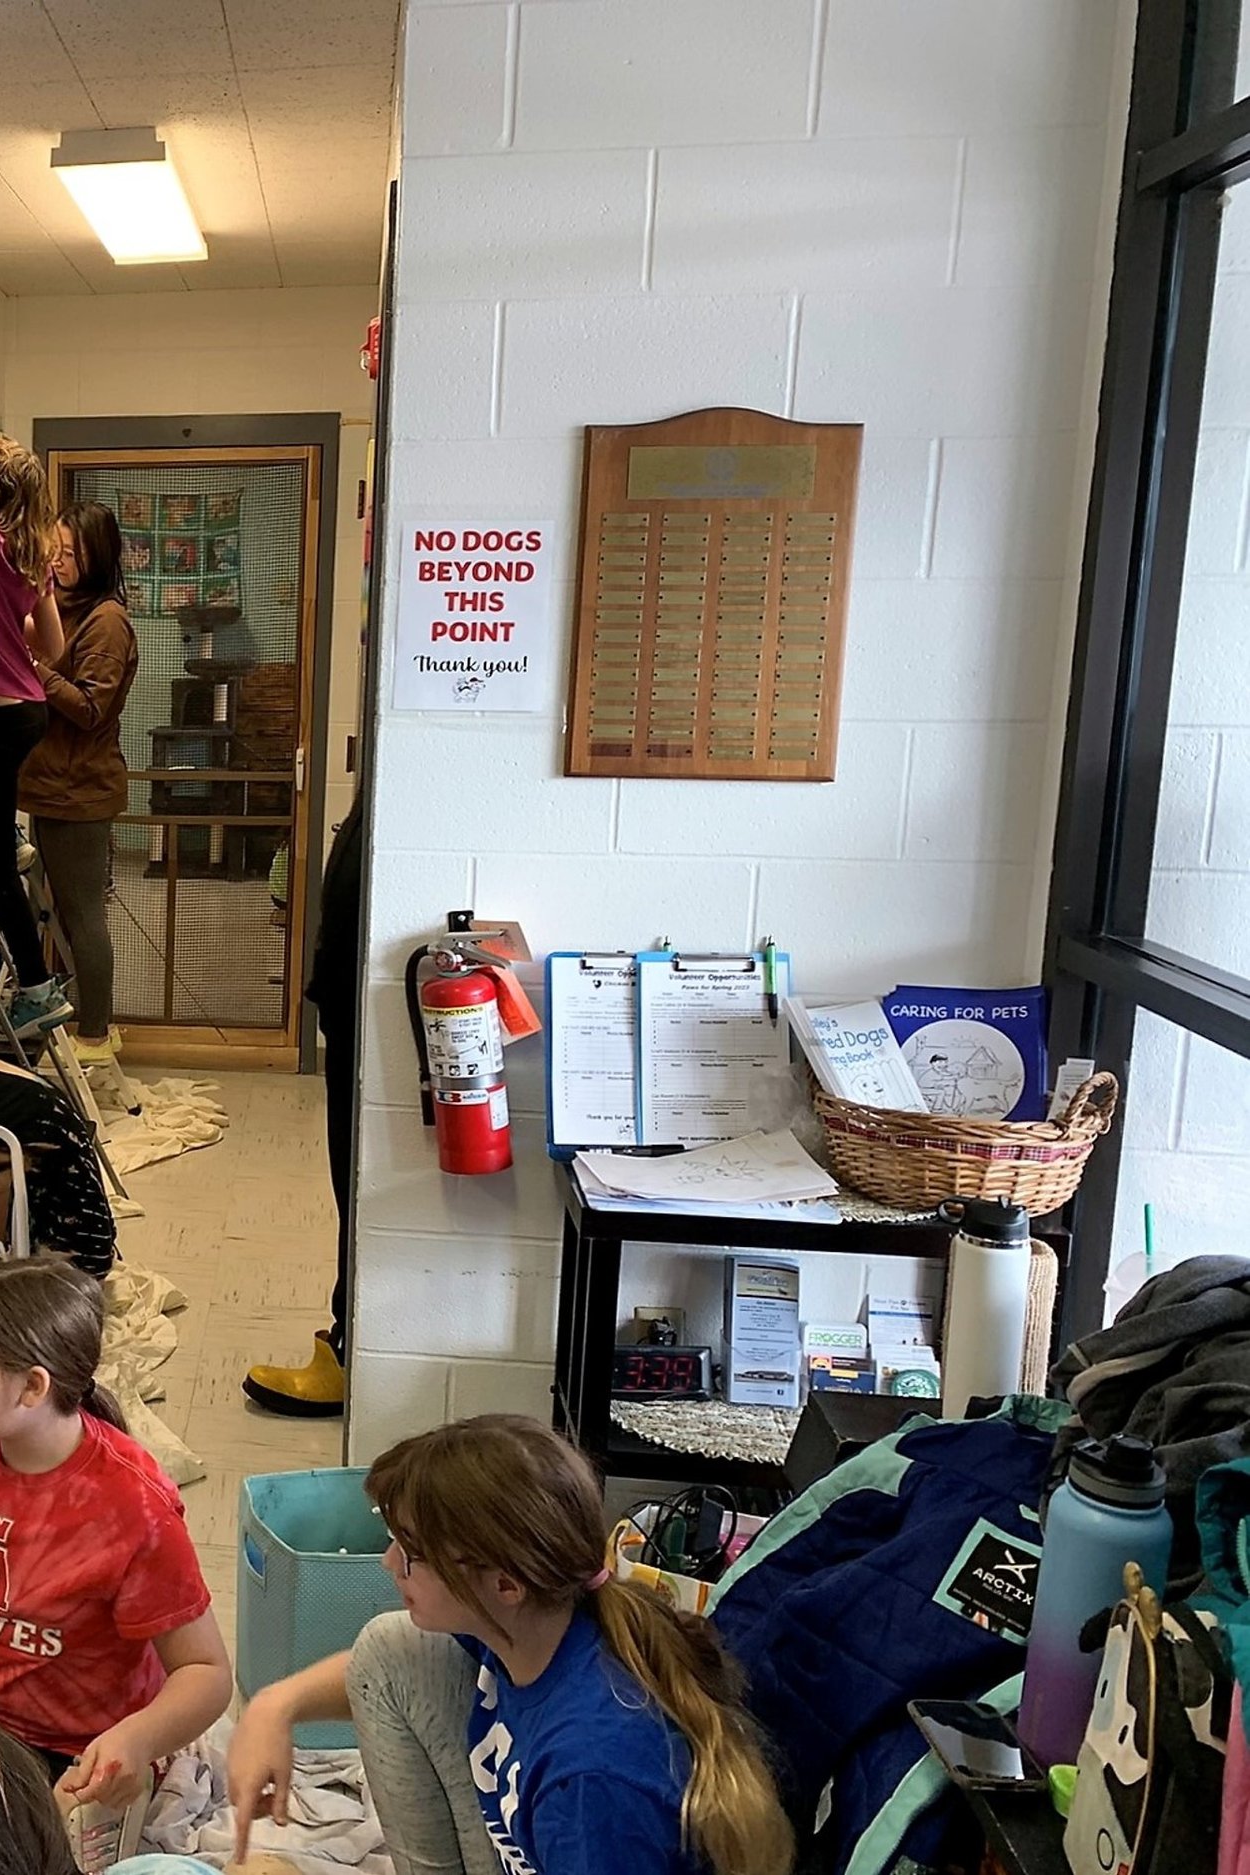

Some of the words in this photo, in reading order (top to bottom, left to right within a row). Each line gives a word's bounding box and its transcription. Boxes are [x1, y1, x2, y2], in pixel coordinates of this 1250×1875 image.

[415, 530, 456, 551] NO
[462, 530, 542, 552] DOGS
[418, 561, 534, 582] BEYOND
[444, 591, 504, 612] THIS
[431, 622, 515, 643] POINT
[413, 655, 480, 673] Thank
[482, 655, 528, 677] you!
[708, 974, 761, 982] Opportunities
[890, 1004, 948, 1018] CARING
[954, 1006, 985, 1019] FOR
[992, 1006, 1029, 1019] PETS
[843, 1028, 889, 1047] Dogs
[846, 1049, 874, 1063] Book
[809, 1332, 863, 1344] FROGGER
[622, 1356, 694, 1391] 3:39
[972, 1567, 1035, 1606] ARCTIX
